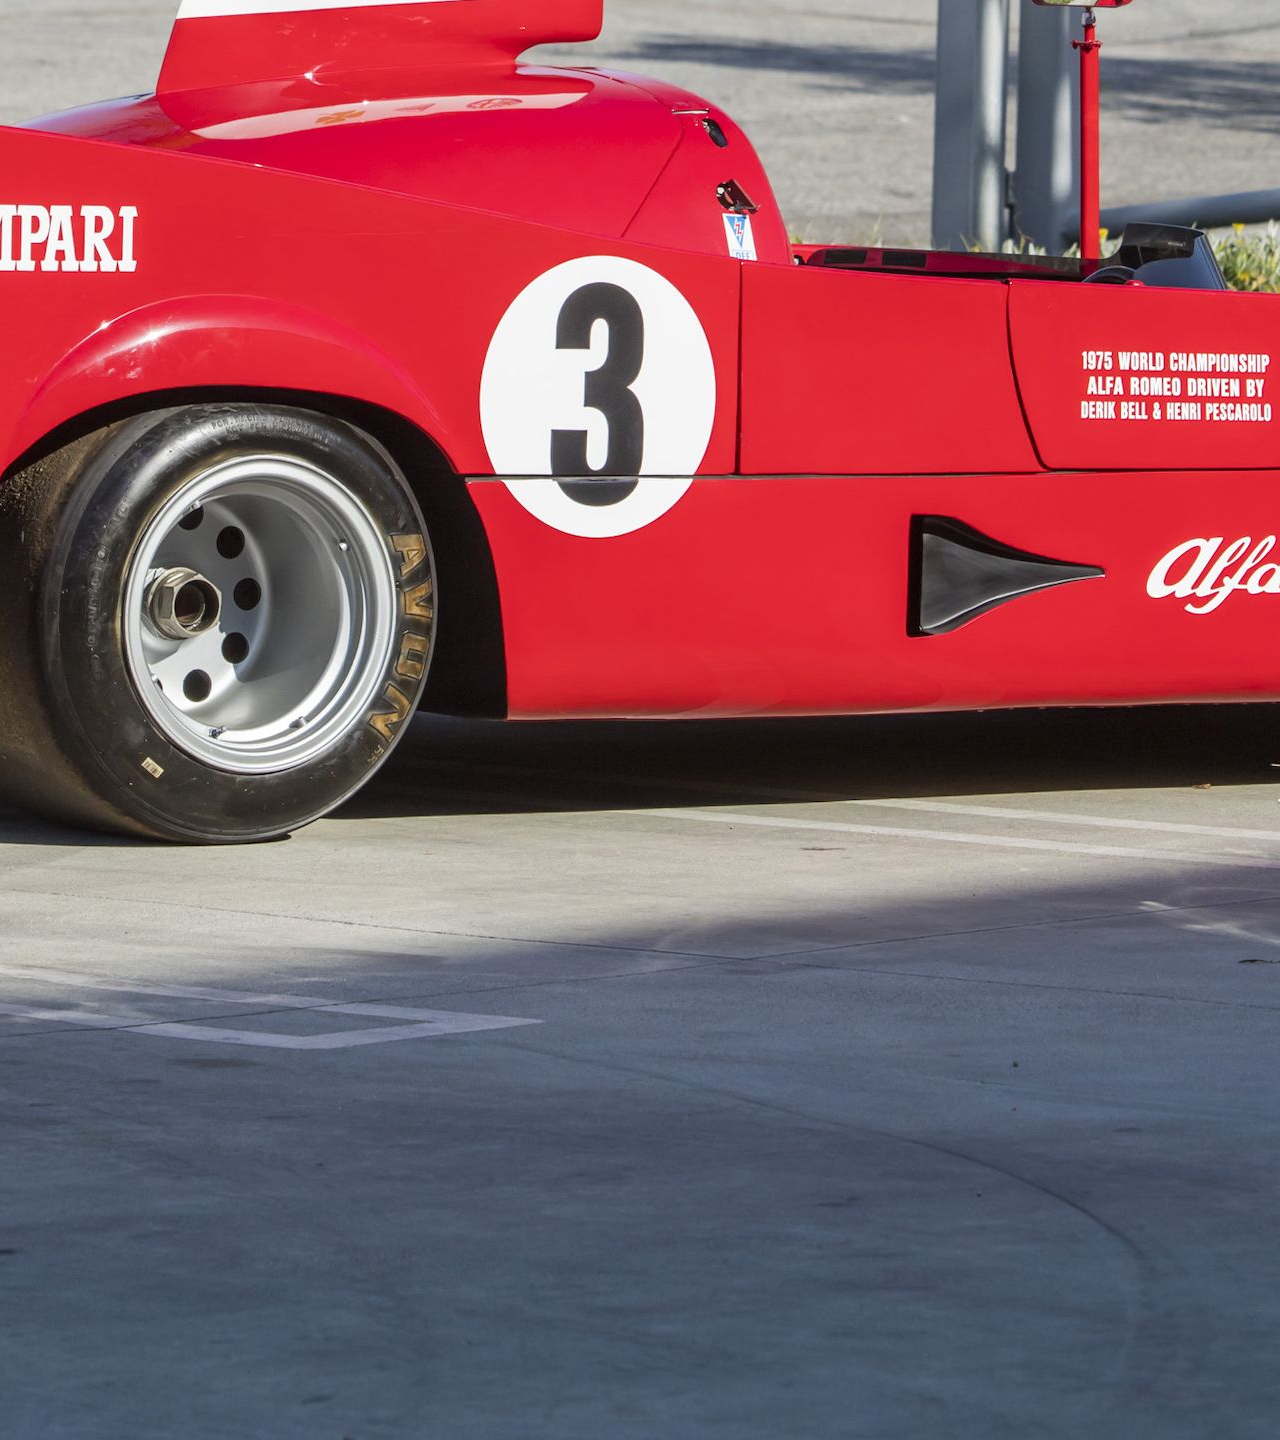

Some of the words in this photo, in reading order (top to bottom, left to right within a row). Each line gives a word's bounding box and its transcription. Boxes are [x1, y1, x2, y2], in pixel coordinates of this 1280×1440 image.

[1081, 351, 1112, 370] 1975
[1118, 351, 1164, 371] WORLD
[1169, 352, 1270, 373] CHAMPIONSHIP
[550, 281, 645, 507] 3
[1087, 376, 1124, 395] ALFA
[1130, 377, 1181, 396] ROMEO
[1187, 378, 1240, 397] DRIVEN
[1246, 379, 1264, 398] BY
[1081, 401, 1116, 419] DERIK
[1121, 401, 1148, 420] BELL
[1153, 402, 1161, 420] &
[1167, 402, 1201, 421] HENRI
[1206, 403, 1271, 422] PESCAROLO
[369, 533, 434, 744] AVON
